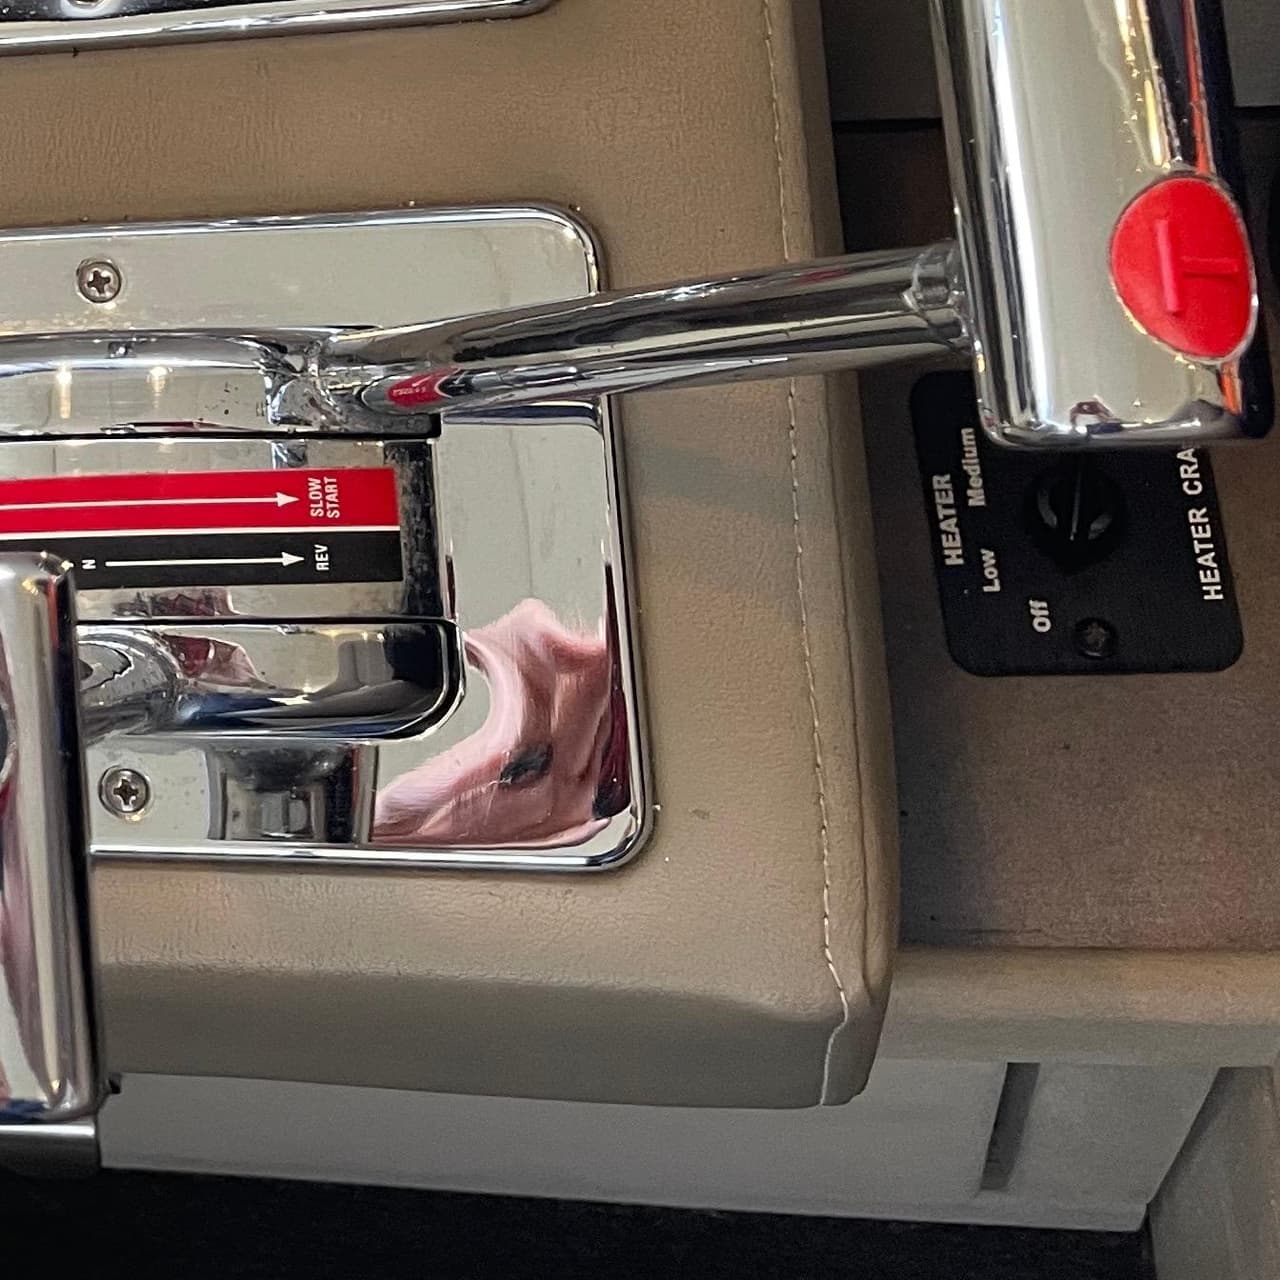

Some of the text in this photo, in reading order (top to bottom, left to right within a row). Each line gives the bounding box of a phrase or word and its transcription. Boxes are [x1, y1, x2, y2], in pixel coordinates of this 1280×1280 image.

[961, 427, 986, 507] Medium
[310, 476, 325, 518] SLOW
[324, 475, 341, 519] START
[932, 473, 964, 566] HEATER
[82, 542, 330, 571] N REV
[981, 548, 1001, 593] Low
[1188, 507, 1224, 600] HEATER
[1029, 598, 1052, 633] Off
